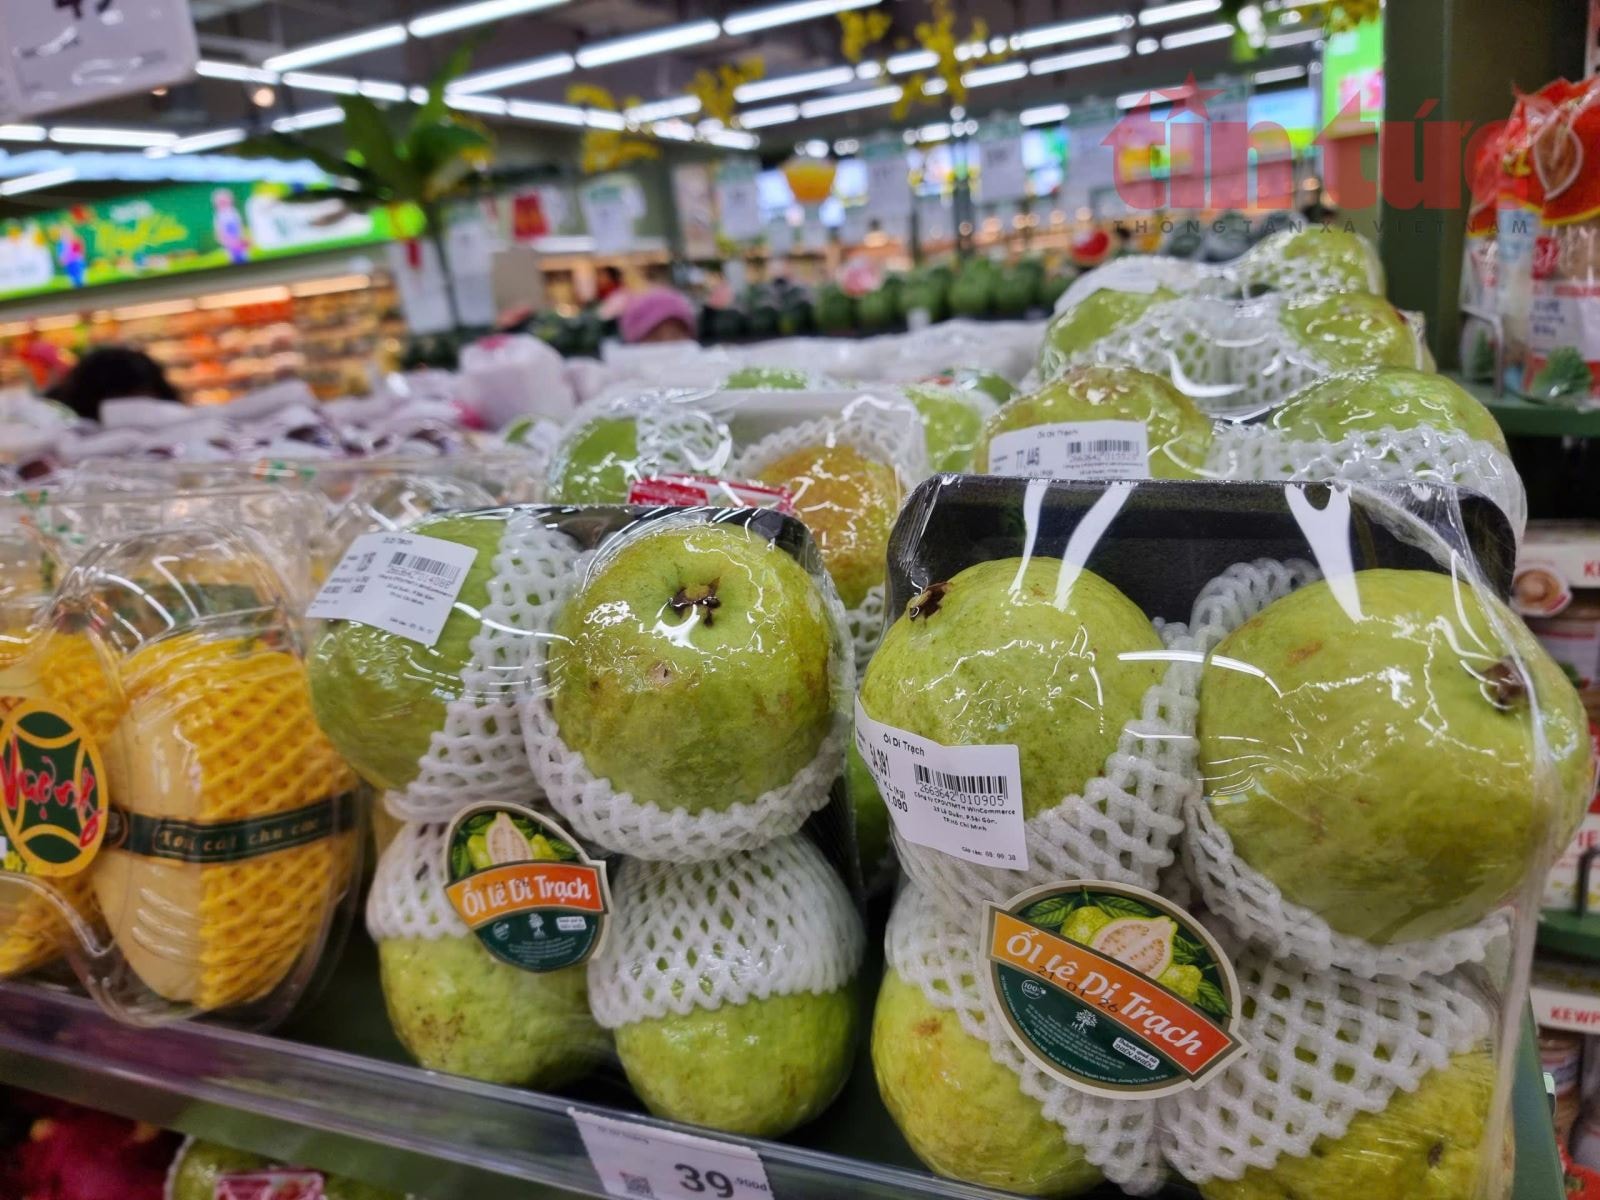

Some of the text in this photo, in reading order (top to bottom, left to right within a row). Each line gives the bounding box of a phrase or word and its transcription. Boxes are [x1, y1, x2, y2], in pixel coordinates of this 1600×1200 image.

[903, 741, 925, 757] Trạch
[919, 782, 1005, 806] 2663642 010905
[967, 806, 1016, 815] WinCommerce
[533, 875, 592, 903] Trạch
[1078, 970, 1121, 1000] Di
[1119, 991, 1204, 1057] Trạch
[674, 1163, 734, 1198] 39
